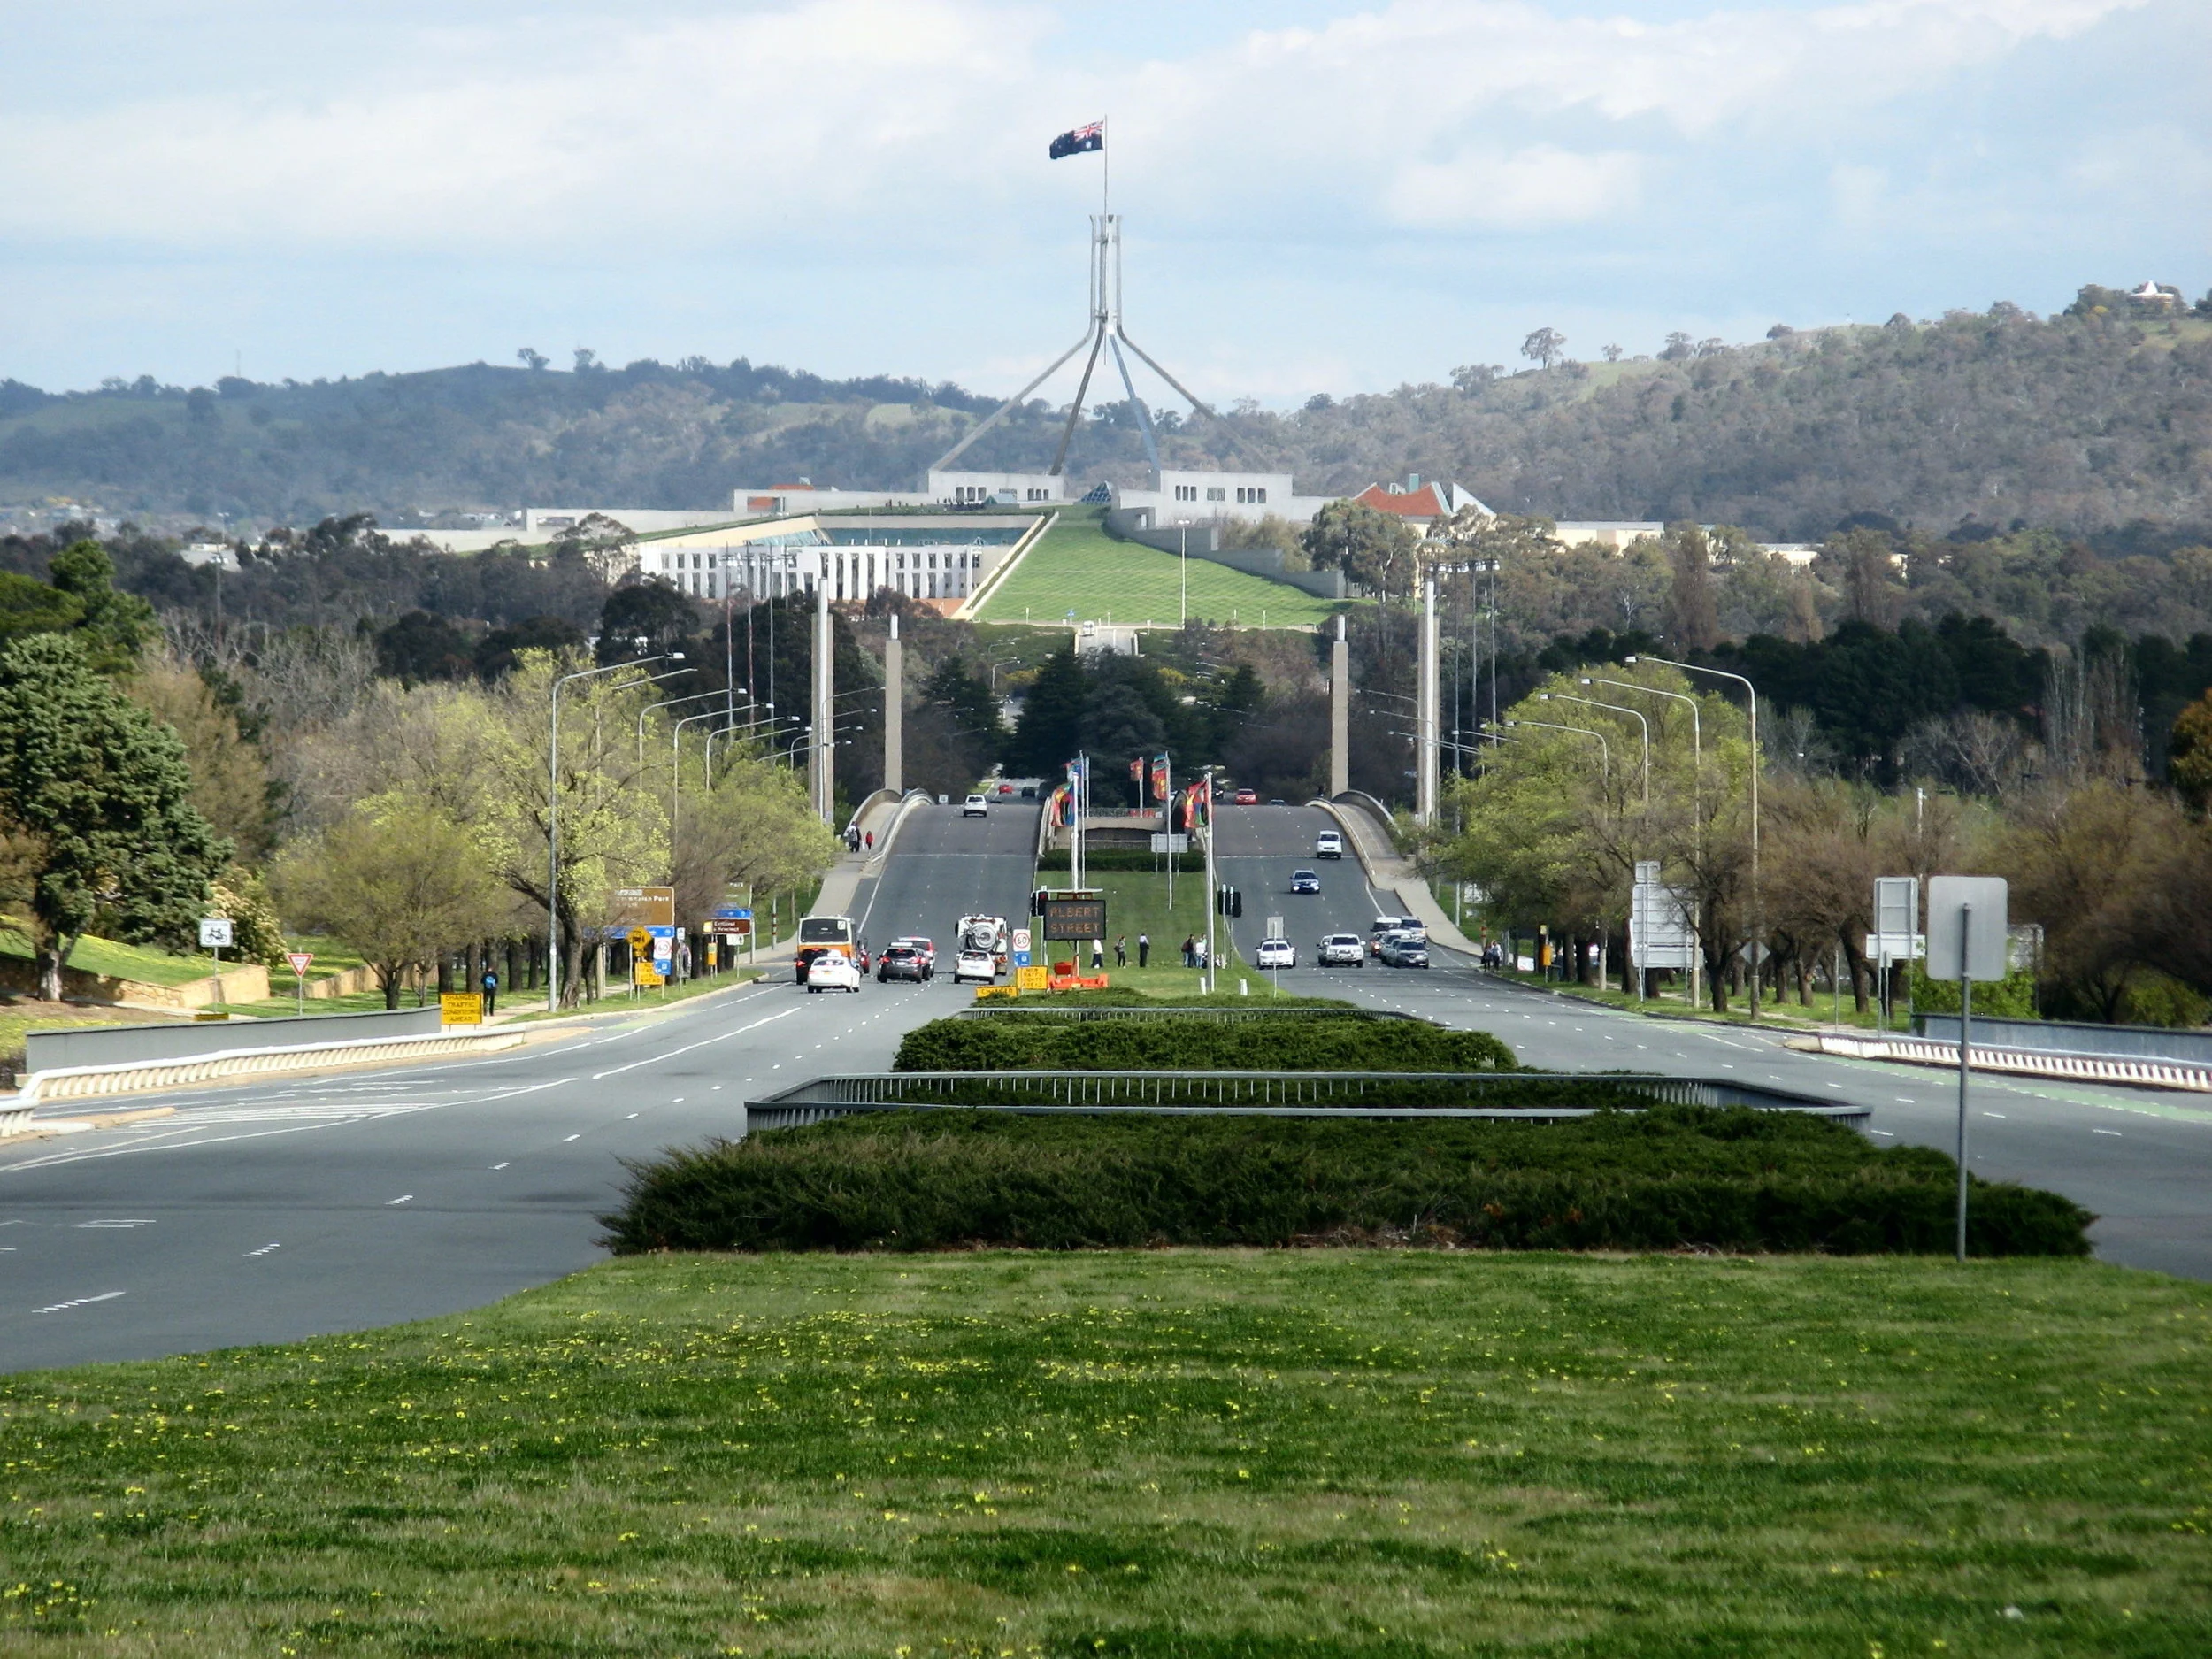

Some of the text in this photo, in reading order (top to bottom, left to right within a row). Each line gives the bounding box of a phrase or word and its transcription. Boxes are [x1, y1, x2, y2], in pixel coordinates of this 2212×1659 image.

[1049, 906, 1100, 918] ALBERT
[1049, 923, 1100, 933] STREET
[1018, 936, 1027, 945] 60
